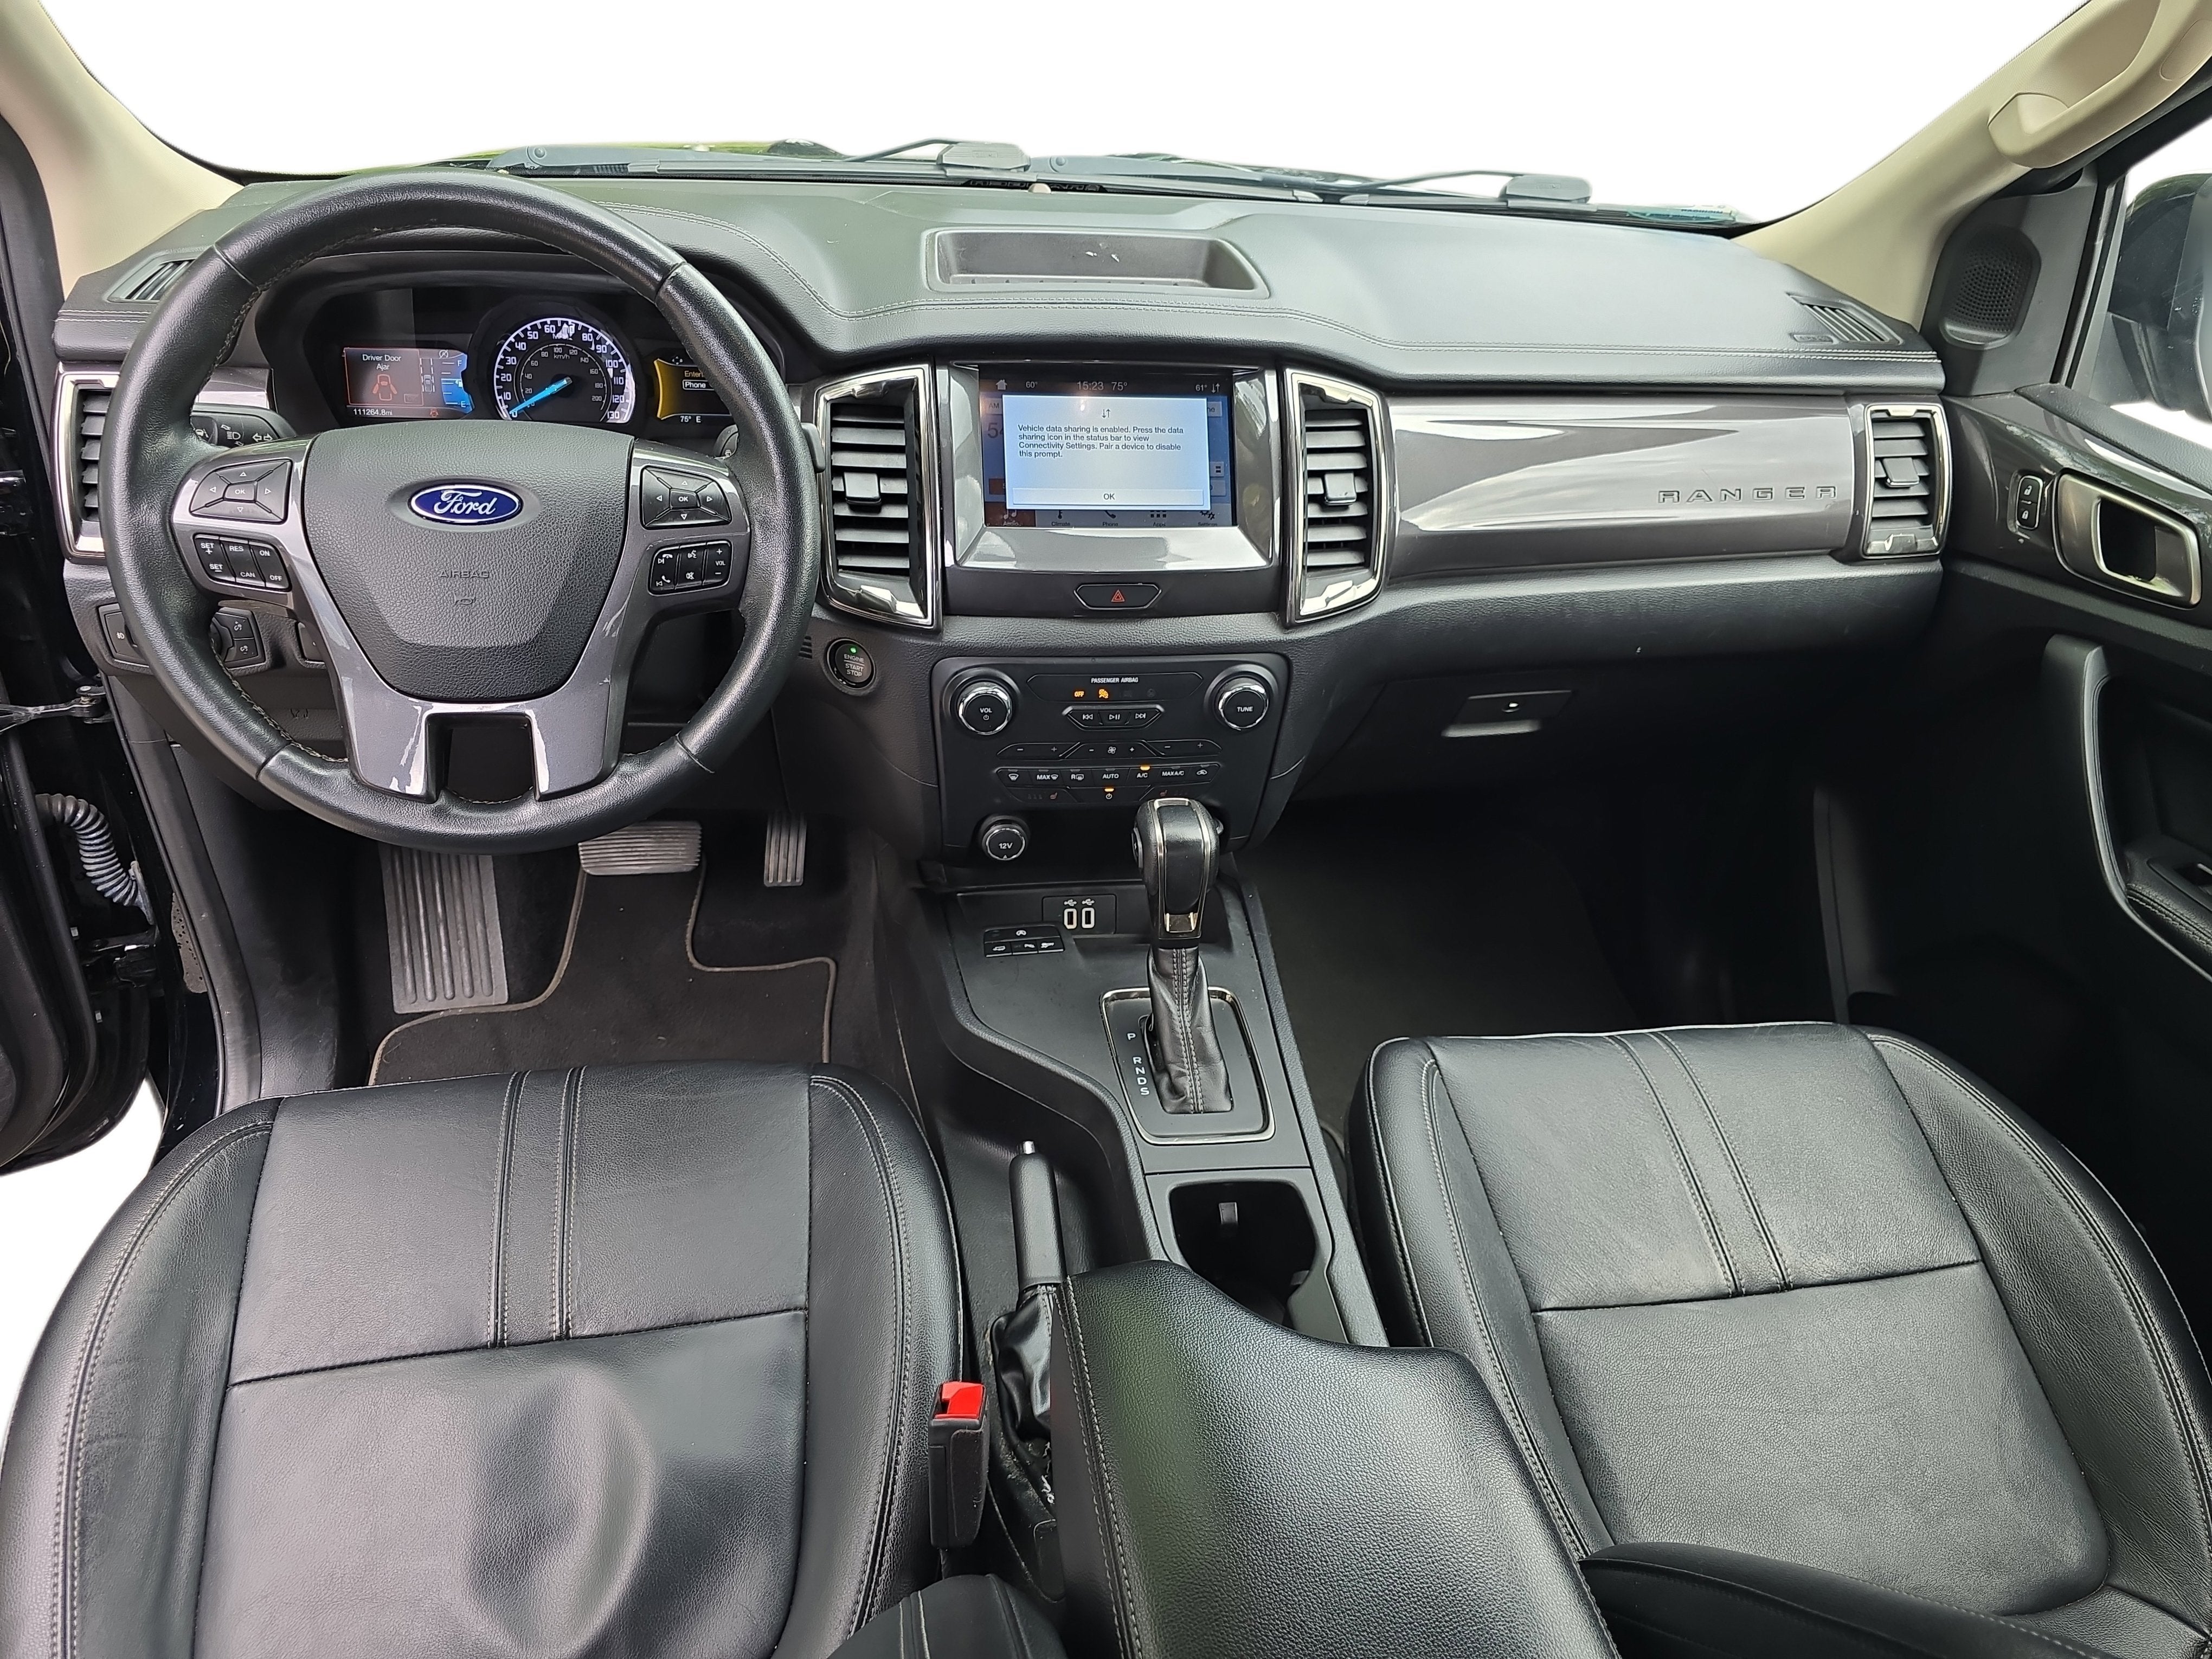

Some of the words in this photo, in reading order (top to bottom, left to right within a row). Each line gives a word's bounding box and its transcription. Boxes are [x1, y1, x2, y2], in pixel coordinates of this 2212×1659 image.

[544, 325, 555, 333] 60
[527, 331, 538, 339] 50
[582, 333, 593, 342] 80
[515, 342, 526, 350] 40
[596, 345, 607, 353] 90
[505, 357, 517, 365] 30
[606, 360, 619, 368] 100
[500, 374, 512, 382] 20
[614, 377, 623, 385] 110
[1077, 381, 1104, 390] 15:23
[1111, 382, 1128, 391] 75°
[504, 392, 511, 401] 10
[612, 395, 625, 403] 120
[607, 411, 620, 419] 130
[1064, 425, 1090, 434] sharing
[1018, 433, 1045, 442] sharing
[1019, 442, 1064, 451] Connectivity
[1066, 442, 1097, 451] Settings.
[1658, 486, 1836, 503] RANGER
[434, 490, 498, 515] Ford
[440, 570, 490, 578] AIRBAG
[844, 654, 864, 663] ENGINE
[845, 664, 864, 672] START
[1135, 1066, 1146, 1075] N
[1137, 1077, 1147, 1085] D
[1140, 1087, 1150, 1095] S
